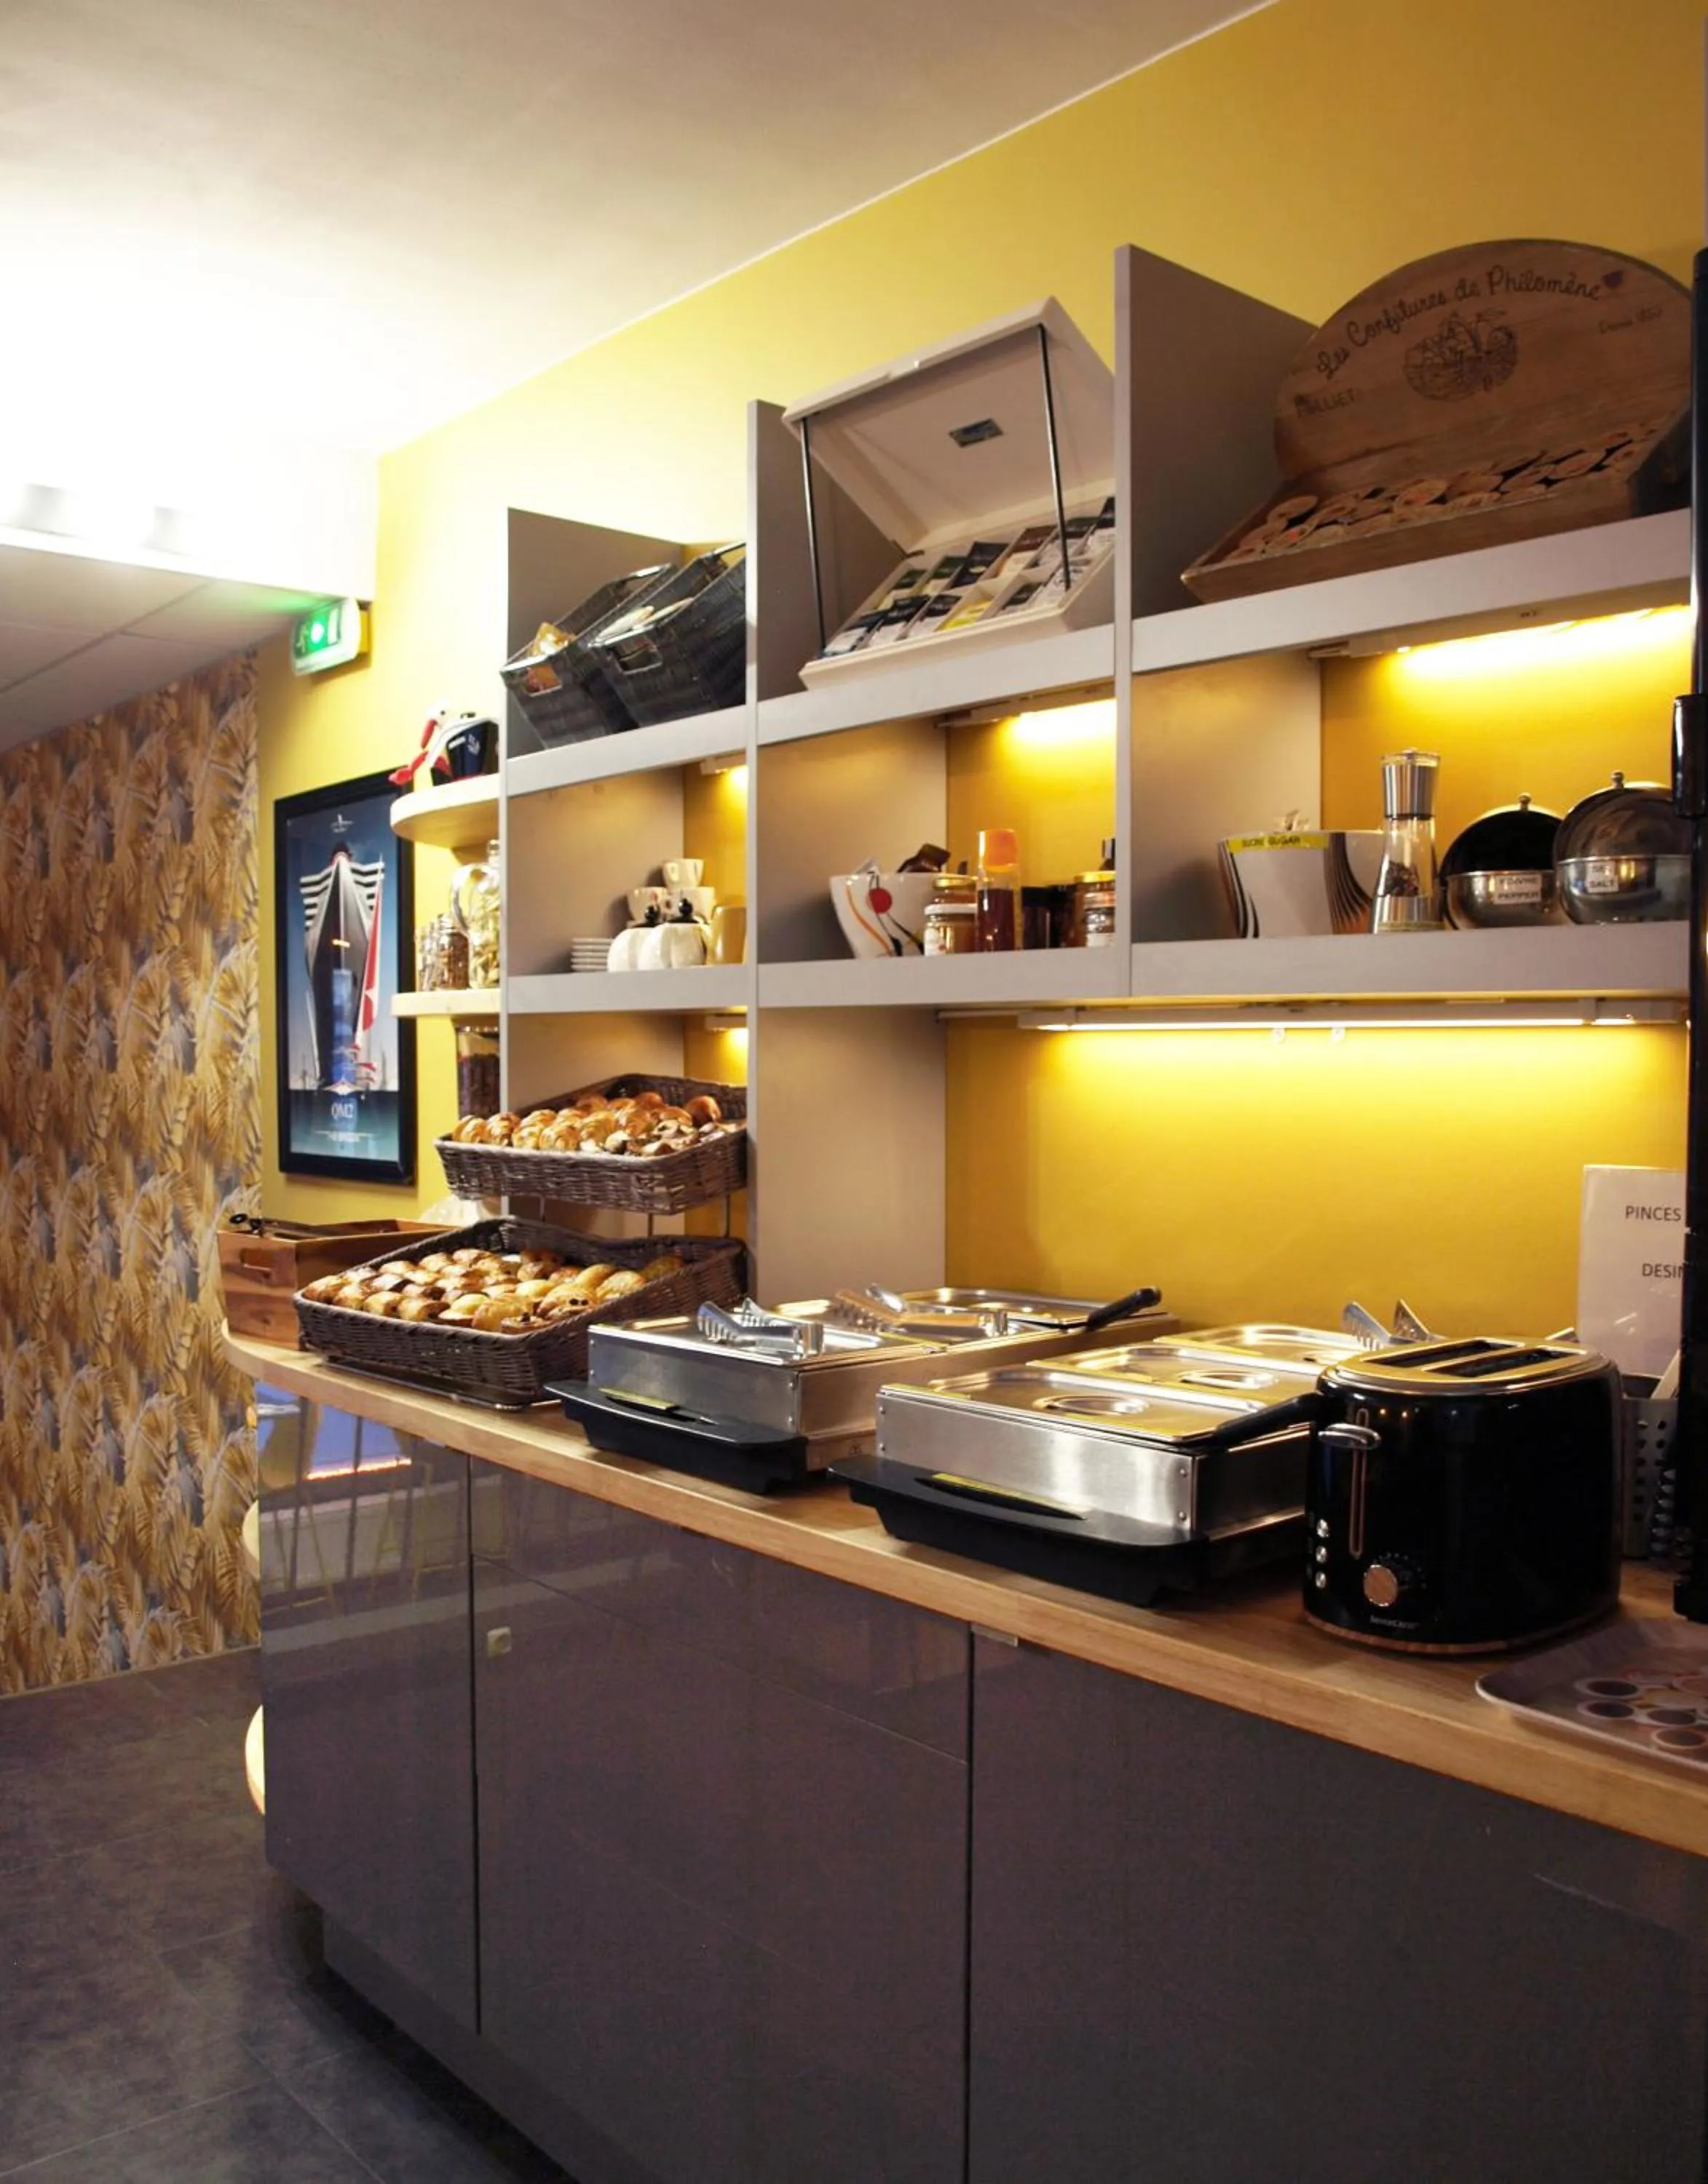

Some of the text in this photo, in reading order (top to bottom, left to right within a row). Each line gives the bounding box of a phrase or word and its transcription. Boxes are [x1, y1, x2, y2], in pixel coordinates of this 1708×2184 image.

[1347, 290, 1446, 347] Confitures
[1455, 276, 1479, 301] de
[1625, 1205, 1682, 1222] PINCES
